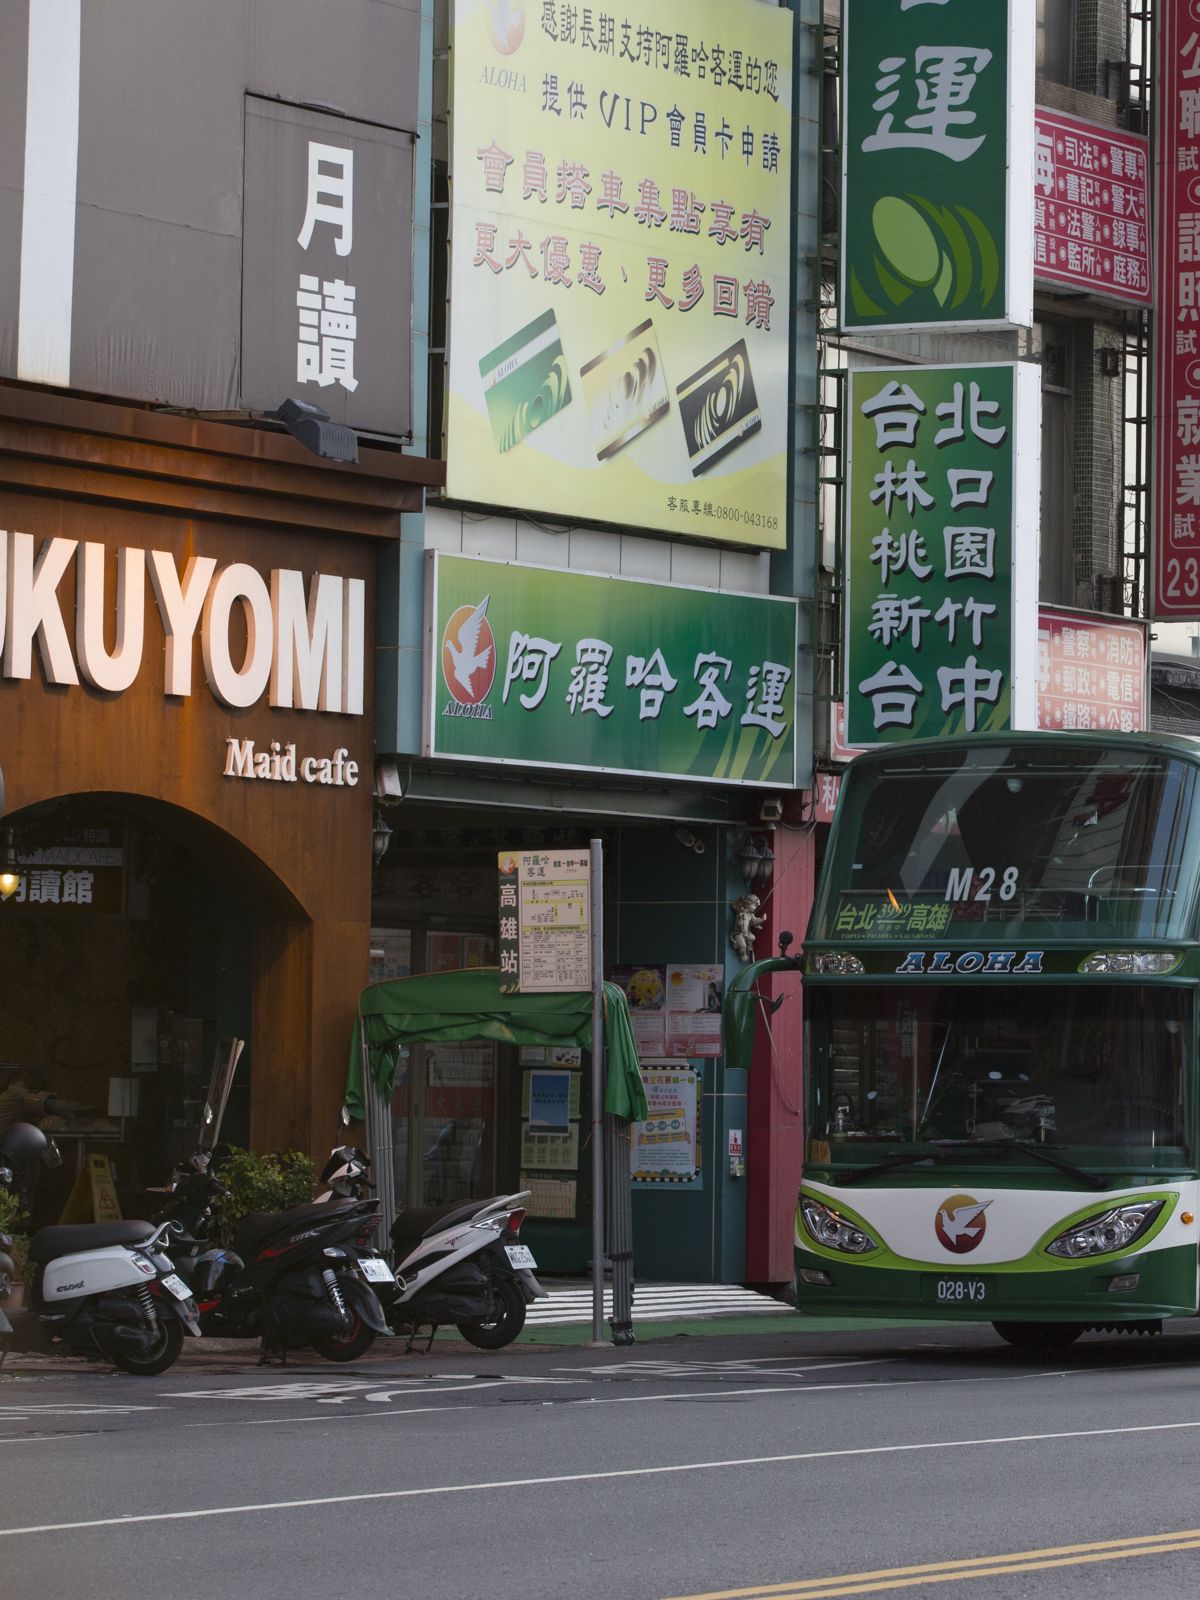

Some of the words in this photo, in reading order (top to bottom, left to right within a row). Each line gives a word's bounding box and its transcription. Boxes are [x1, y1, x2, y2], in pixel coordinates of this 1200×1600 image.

[479, 65, 527, 93] ALOHA
[541, 1, 779, 103] 感謝長期支持阿羅哈客運的您
[861, 0, 993, 162] 運
[477, 141, 771, 256] 會員搭車集點享有
[296, 140, 359, 393] 月讀
[0, 530, 366, 715] KUYOMI
[442, 701, 495, 721] ALOHA
[502, 631, 791, 738] 阿羅哈客運
[223, 737, 297, 782] Maid
[301, 748, 359, 786] cafe
[500, 884, 518, 973] 高雄站
[944, 867, 1019, 902] M28
[896, 950, 1044, 974] ALOHA
[937, 1279, 985, 1300] 028-V3
